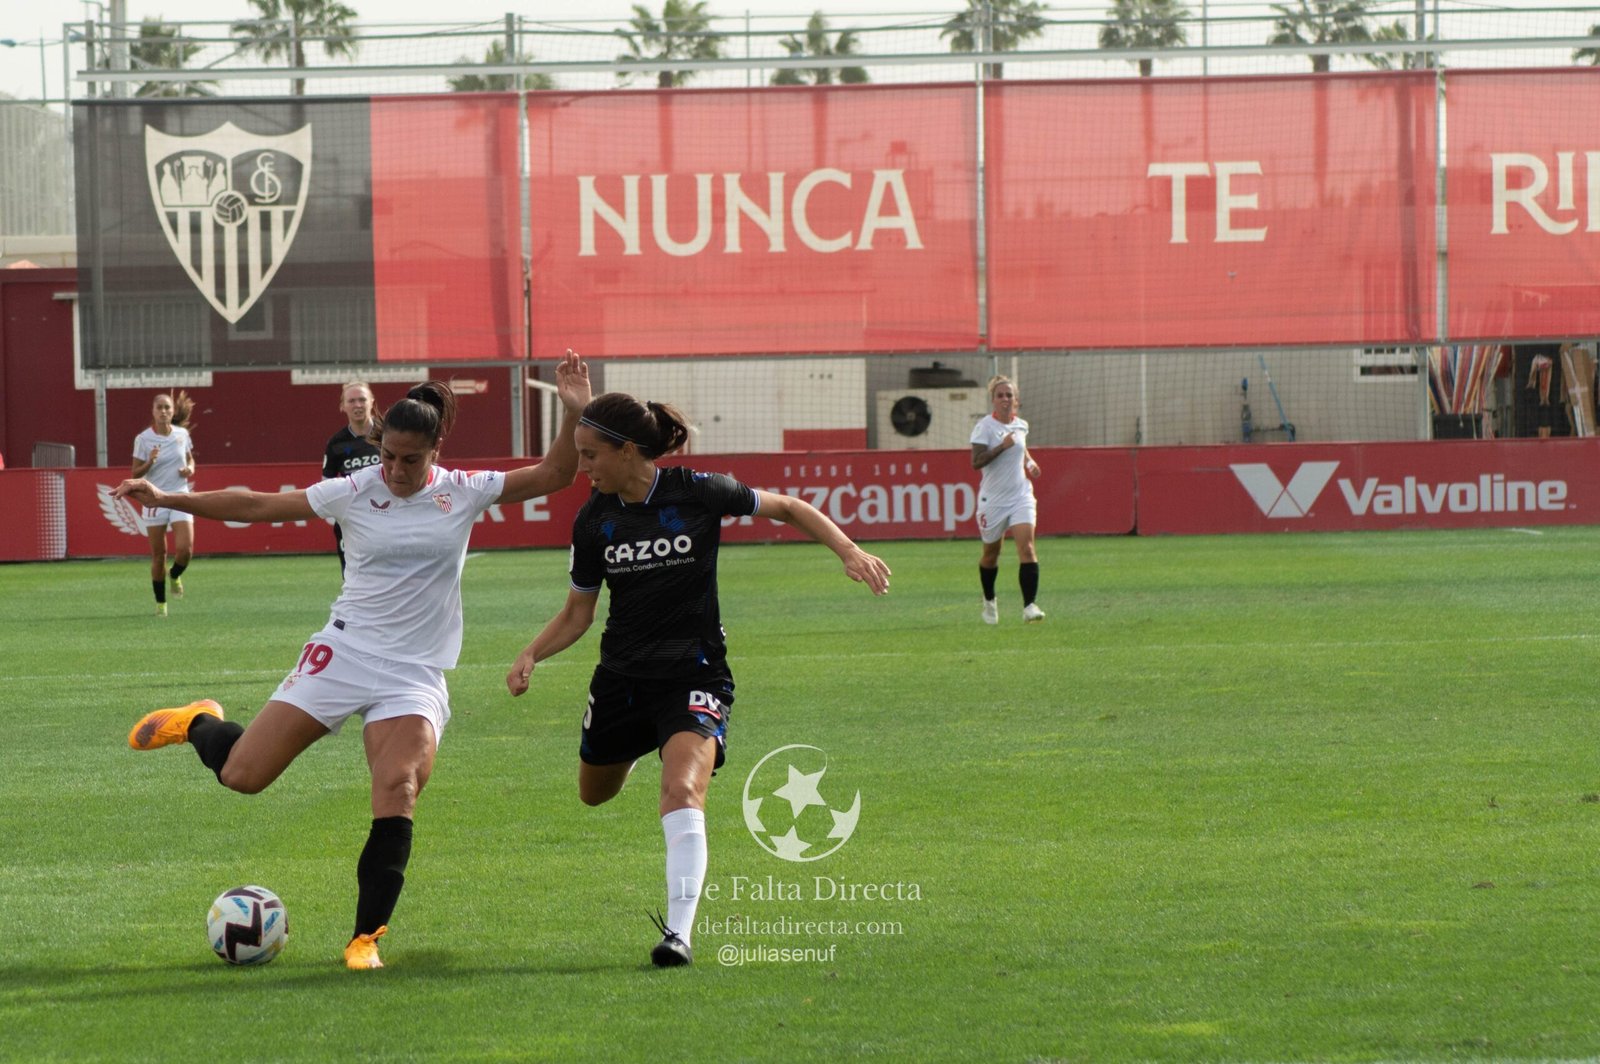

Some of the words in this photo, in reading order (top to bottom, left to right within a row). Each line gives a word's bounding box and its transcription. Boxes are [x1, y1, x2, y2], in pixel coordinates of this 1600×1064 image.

[578, 168, 924, 257] NUNCA
[1147, 161, 1268, 243] TE
[1490, 151, 1600, 235] RI
[344, 455, 380, 469] CAZO
[784, 464, 853, 478] DESDE
[1338, 474, 1568, 516] Valvoline
[604, 534, 692, 564] CAZOO
[297, 642, 334, 676] 19
